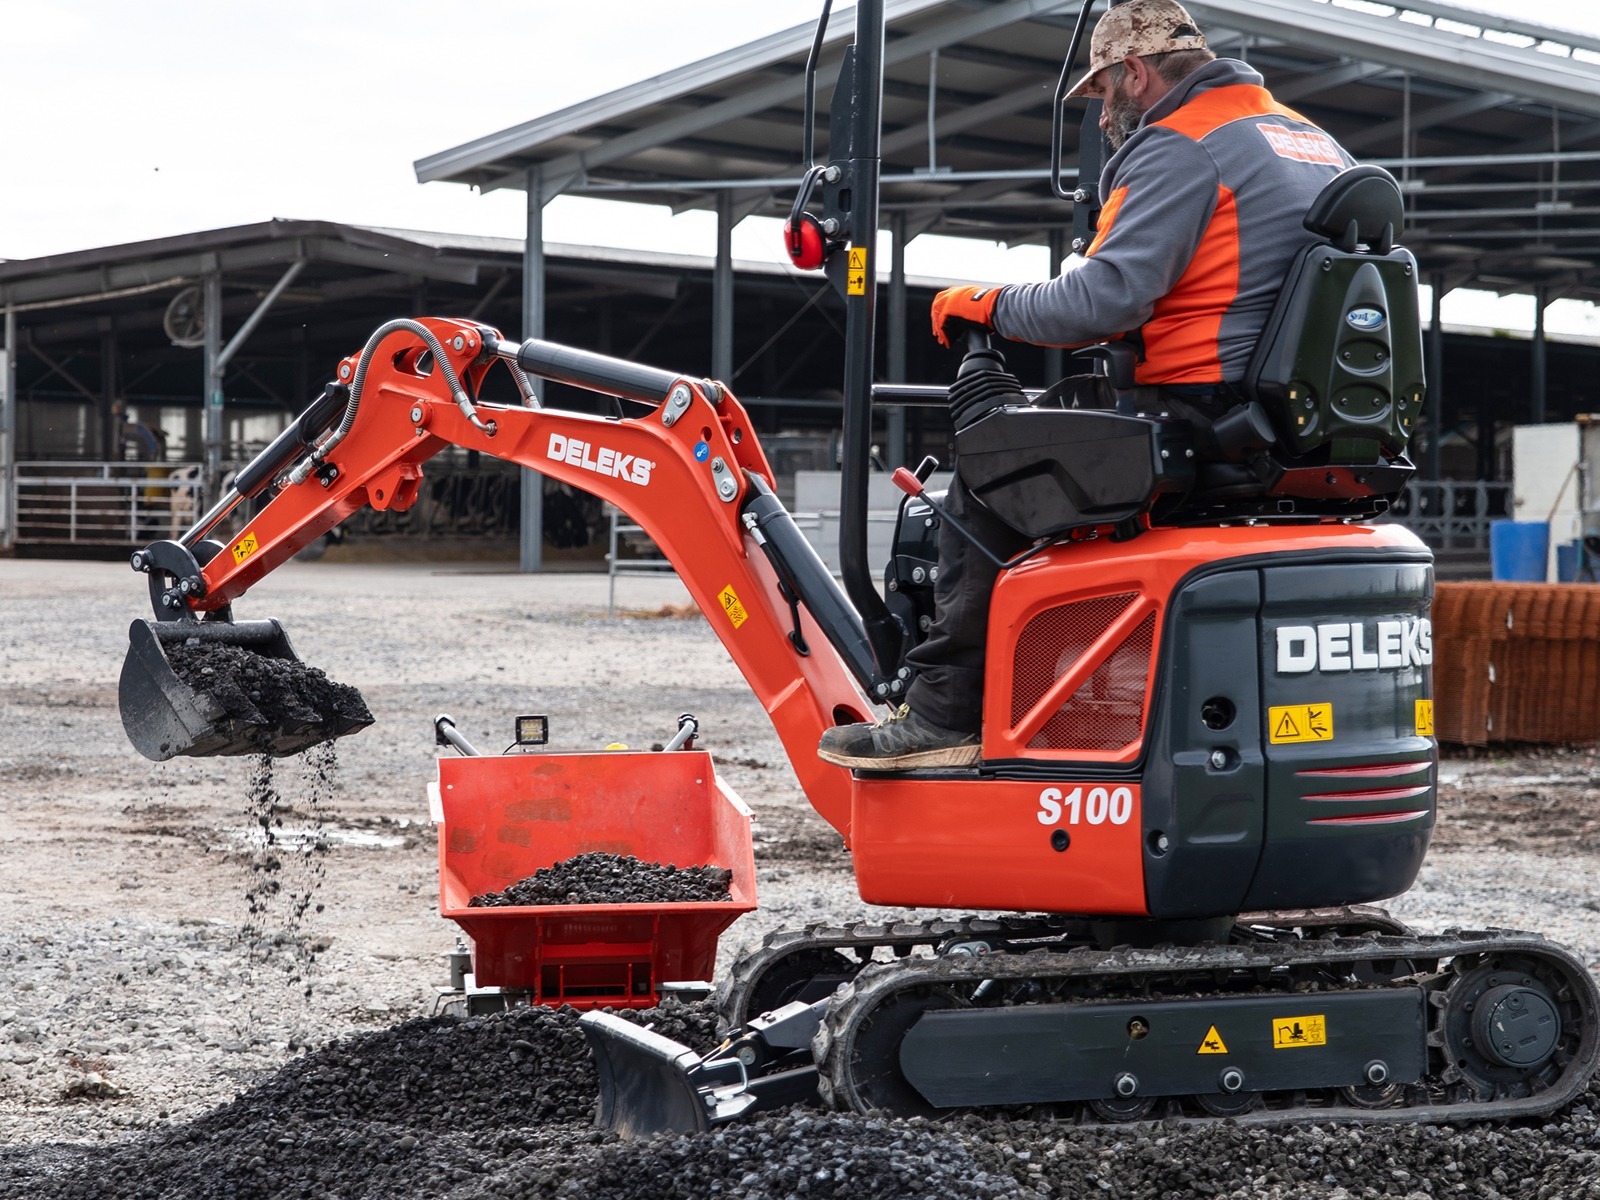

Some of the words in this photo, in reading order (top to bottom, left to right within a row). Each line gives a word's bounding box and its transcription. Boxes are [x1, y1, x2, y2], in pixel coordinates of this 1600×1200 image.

[1264, 131, 1338, 159] DELEKS
[1276, 617, 1432, 673] DELEKS
[1037, 787, 1132, 825] S100
